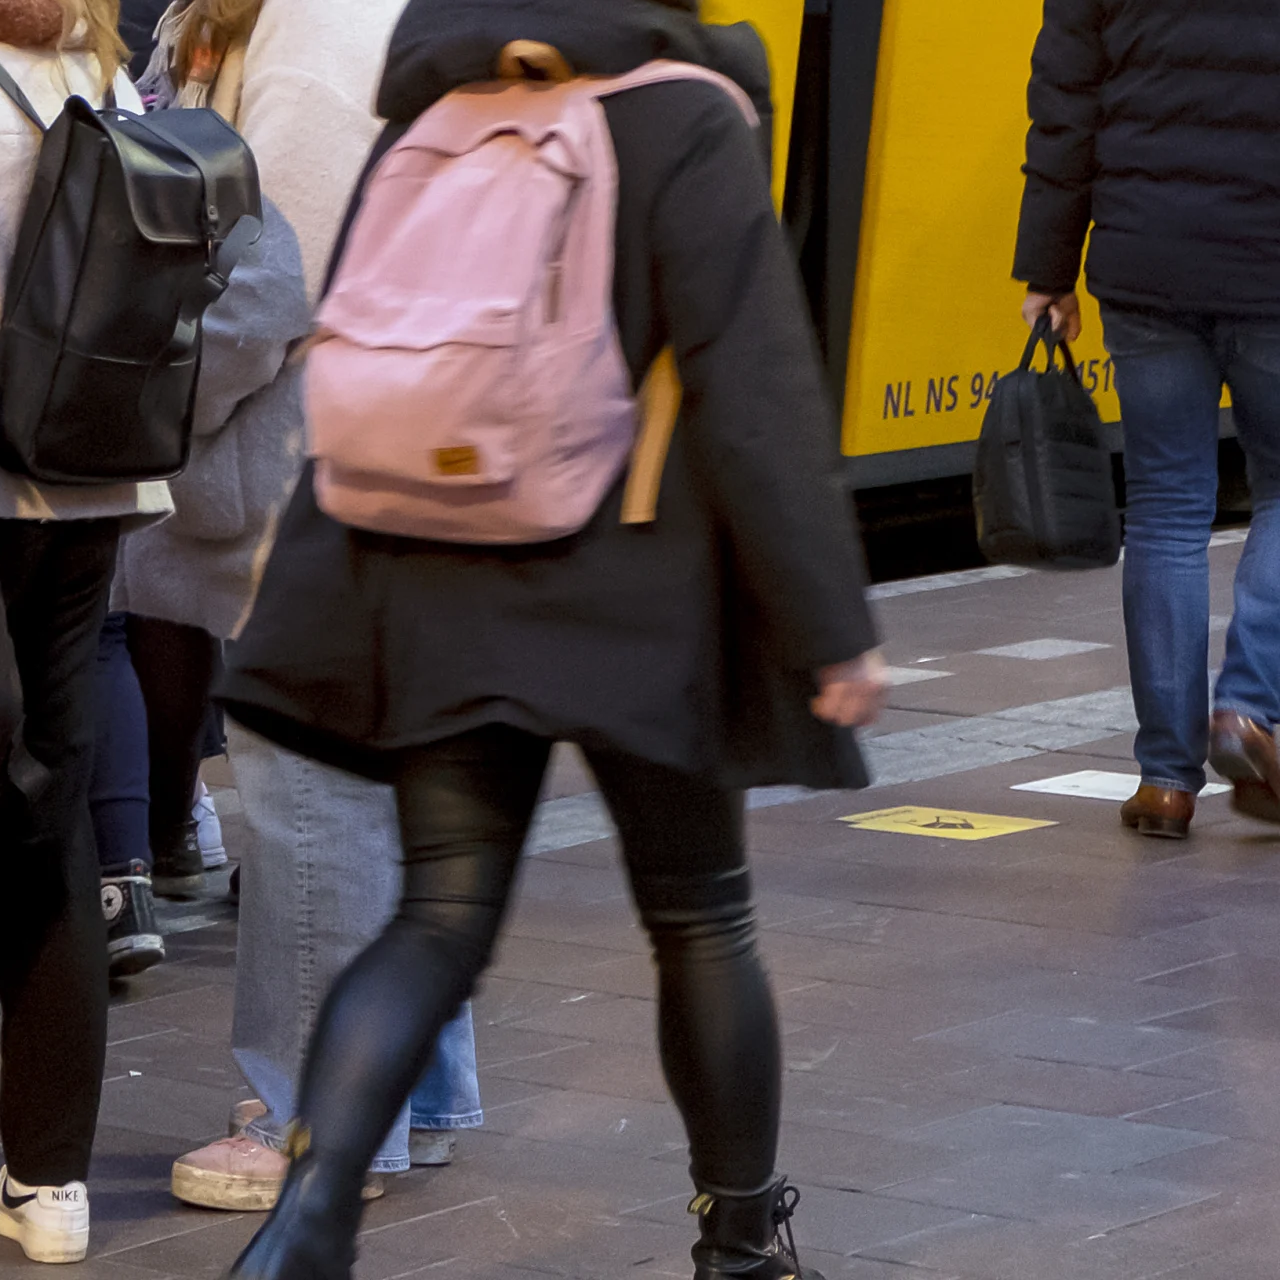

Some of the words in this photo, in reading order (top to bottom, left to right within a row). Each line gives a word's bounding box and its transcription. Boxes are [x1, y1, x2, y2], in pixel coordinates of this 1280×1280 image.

[883, 381, 915, 419] NL
[926, 374, 959, 414] NS
[1075, 358, 1118, 395] 151
[52, 1190, 79, 1202] NIKE
